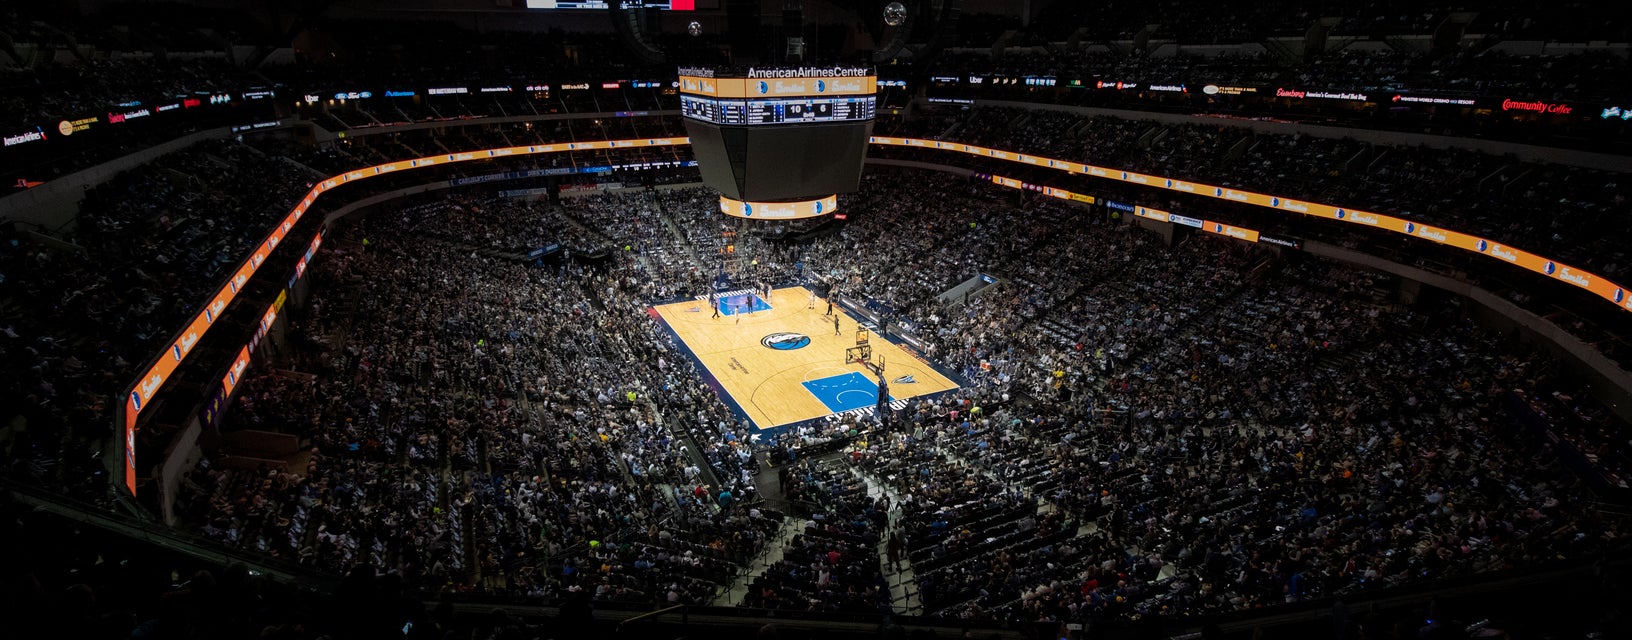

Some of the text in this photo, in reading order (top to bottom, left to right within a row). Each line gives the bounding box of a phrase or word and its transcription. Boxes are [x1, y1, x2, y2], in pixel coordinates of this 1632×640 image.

[748, 66, 868, 78] AmericanAirlinesCenter
[790, 105, 801, 114] 10
[1502, 98, 1572, 114] Community Coffee
